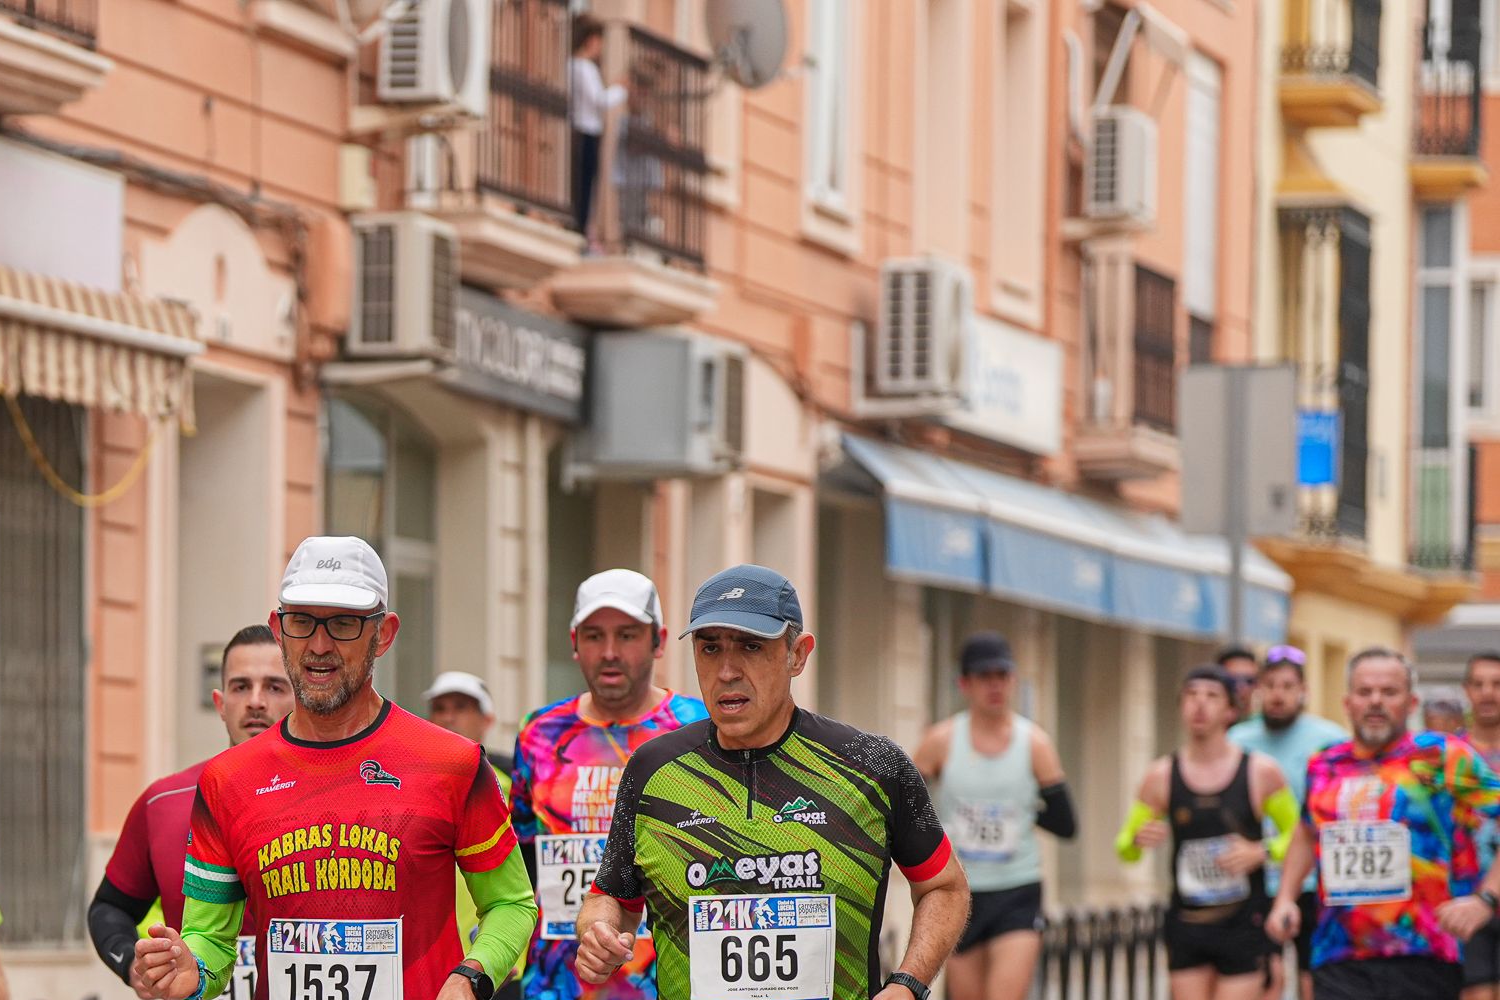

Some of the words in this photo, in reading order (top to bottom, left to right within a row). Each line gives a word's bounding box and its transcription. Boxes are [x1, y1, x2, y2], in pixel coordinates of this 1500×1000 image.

[316, 557, 341, 571] edp
[255, 780, 297, 796] TEAMERGY
[576, 766, 609, 790] XII
[676, 817, 717, 829] TEAMERGY
[257, 823, 334, 872] KABRAS
[338, 823, 402, 862] LOKAS
[1333, 847, 1392, 876] 1282
[261, 861, 310, 899] TRAIL
[314, 850, 397, 892] KÓRDOBA
[771, 876, 822, 889] TRAIL
[710, 900, 753, 929] 21K
[778, 917, 796, 926] 2026
[283, 922, 321, 953] 21K
[345, 943, 363, 952] 2026
[721, 935, 798, 982] 665
